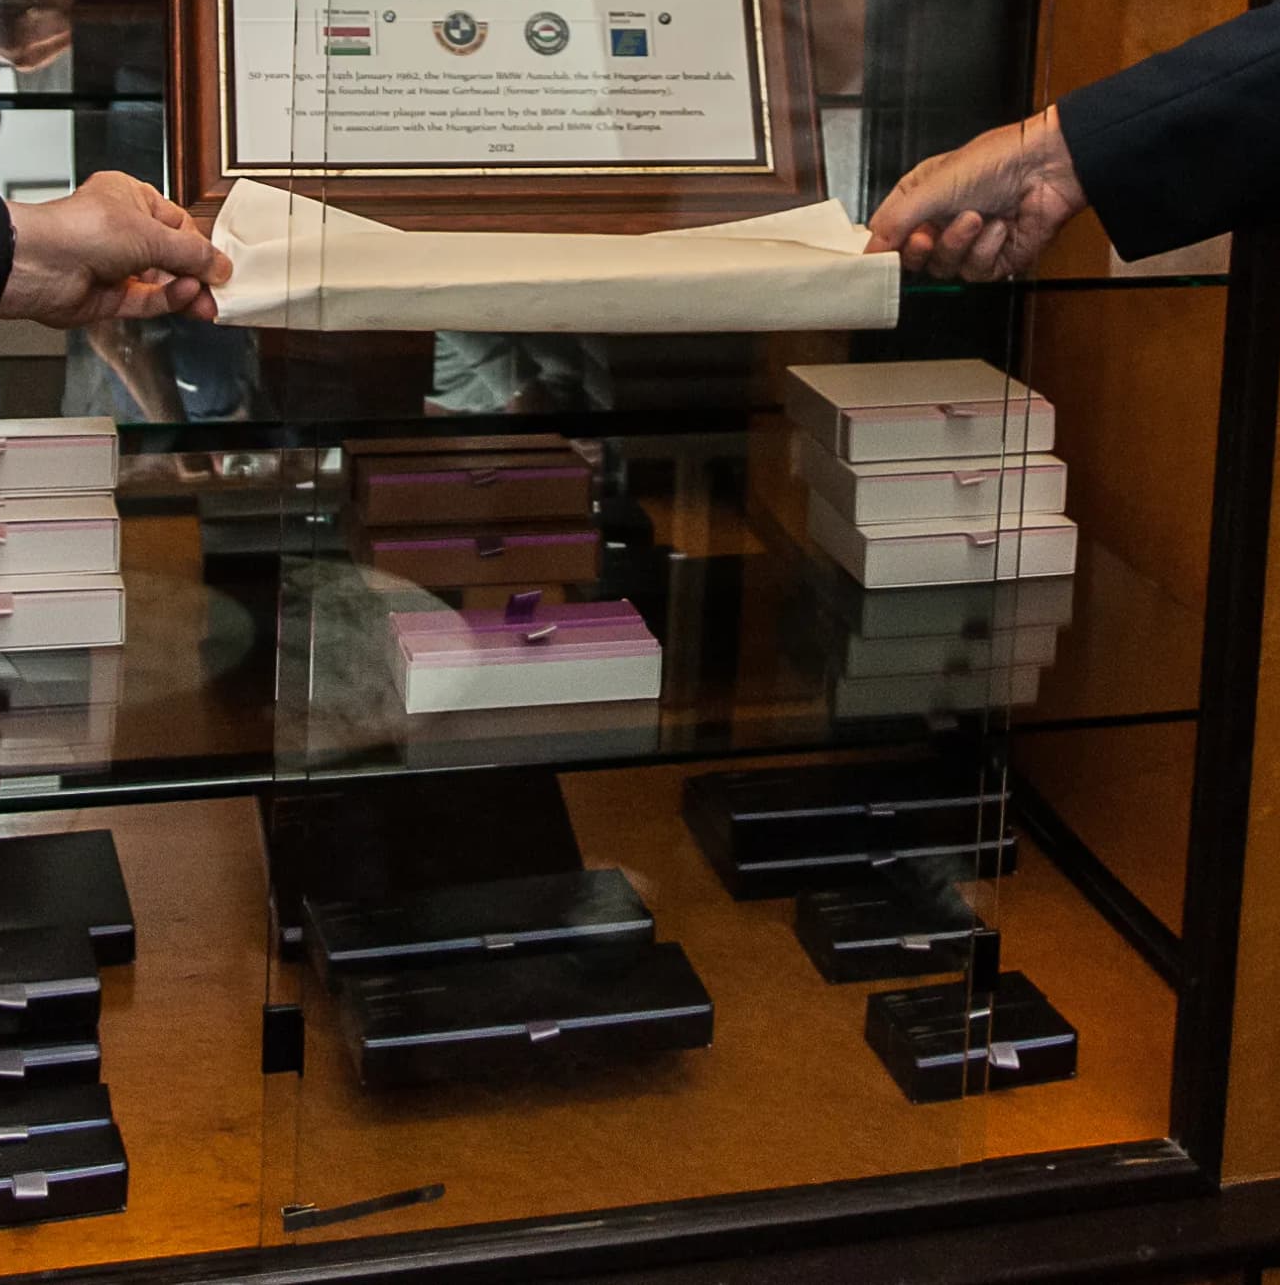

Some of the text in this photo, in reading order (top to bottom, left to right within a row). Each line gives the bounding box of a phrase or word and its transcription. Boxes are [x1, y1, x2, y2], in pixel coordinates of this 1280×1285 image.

[263, 74, 290, 82] years
[424, 72, 440, 80] the
[613, 72, 663, 82] Hungarian
[338, 87, 379, 95] founded
[382, 87, 404, 95] here
[393, 108, 426, 118] plaque
[450, 108, 482, 118] placed
[484, 108, 506, 116] here
[522, 108, 538, 116] the
[403, 123, 425, 132] with
[427, 123, 443, 132] the
[546, 123, 565, 131] and
[488, 143, 515, 153] 2012
